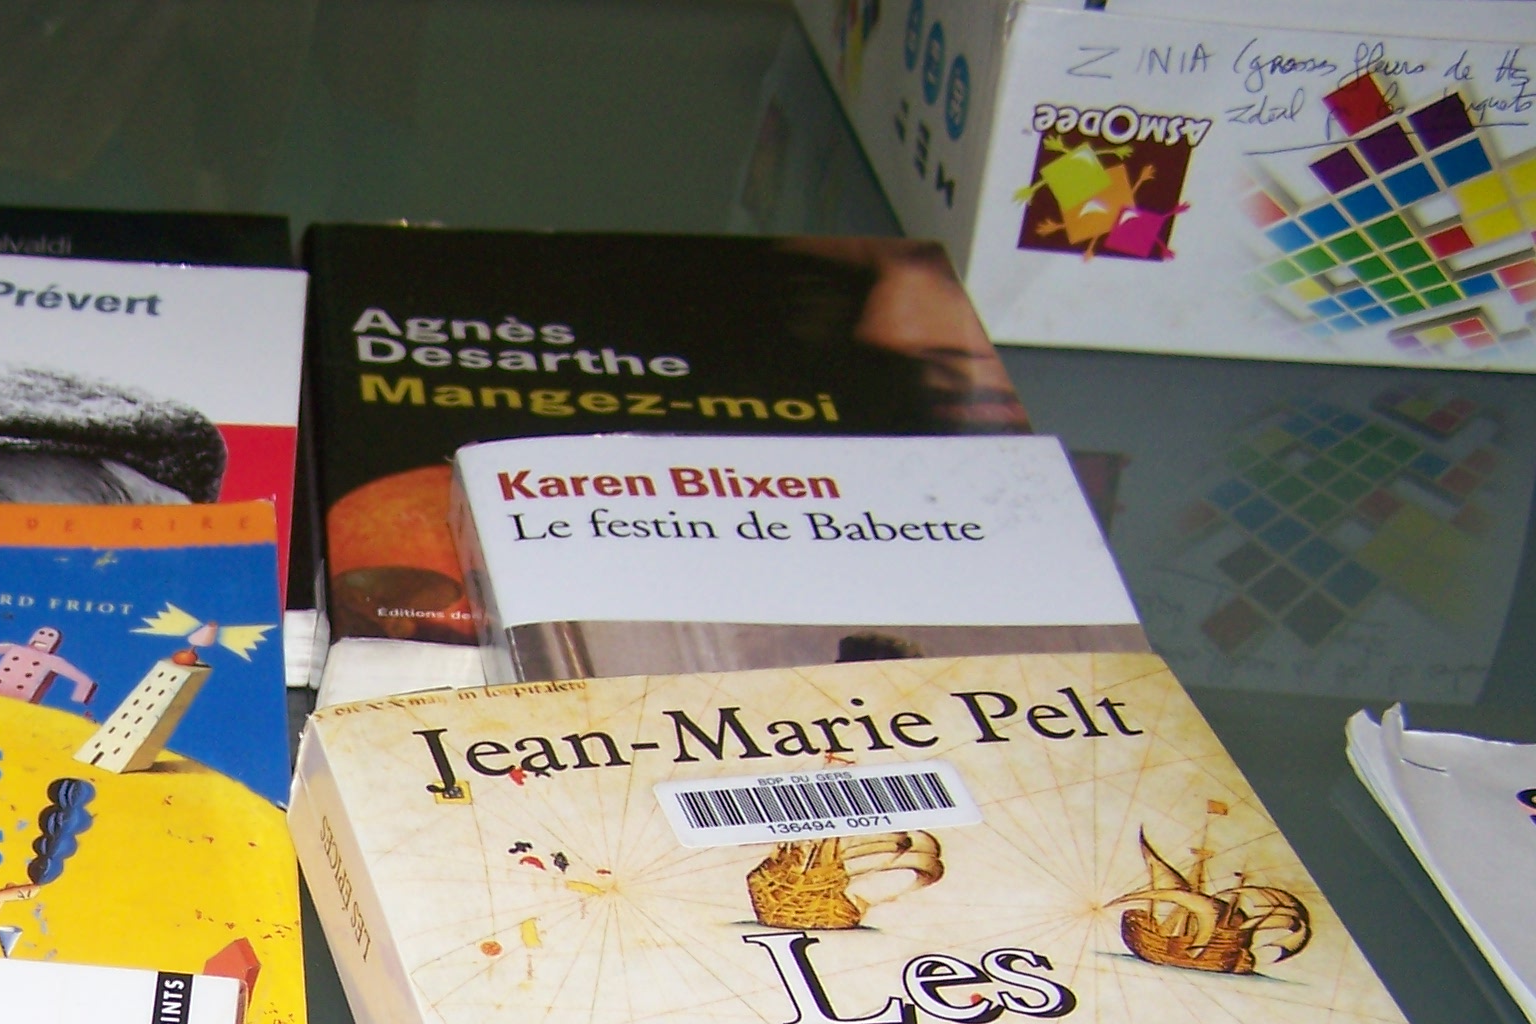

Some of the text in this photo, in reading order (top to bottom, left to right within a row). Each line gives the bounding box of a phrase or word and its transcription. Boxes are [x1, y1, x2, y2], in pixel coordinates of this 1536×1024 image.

[352, 306, 576, 348] Agnès
[355, 335, 691, 378] Desarthe
[357, 373, 841, 423] Mangez-moi
[496, 465, 841, 503] Karen Blixen
[26, 516, 73, 533] DE
[131, 516, 251, 533] RIRE
[512, 508, 987, 545] Le festin de Babette
[49, 597, 134, 616] FRIOT
[377, 607, 445, 618] Éditions
[412, 696, 938, 794] Jean-Marie
[952, 687, 1144, 746] Pelt
[757, 771, 853, 786] BDP DU GERS
[767, 815, 892, 835] 136494 0071
[320, 816, 352, 911] ÉPICES
[350, 901, 372, 963] LES
